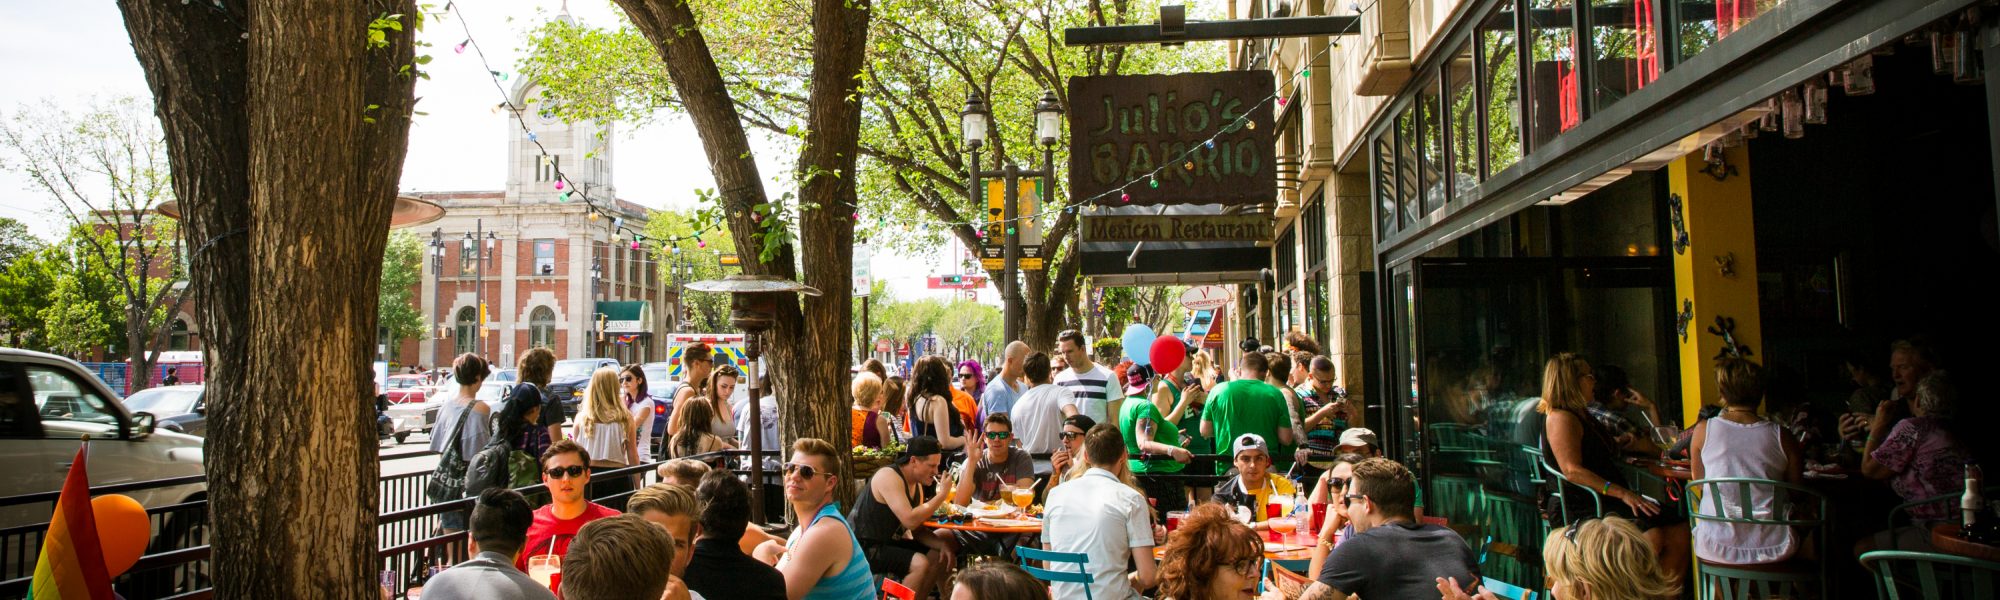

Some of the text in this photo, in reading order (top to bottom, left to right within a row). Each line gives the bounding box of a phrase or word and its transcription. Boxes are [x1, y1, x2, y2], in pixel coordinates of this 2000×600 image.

[1089, 89, 1246, 137] Julio's
[1090, 138, 1261, 188] BARRIO
[1090, 217, 1266, 240] Mexican Restaurant
[1185, 298, 1227, 307] SANDWICHES
